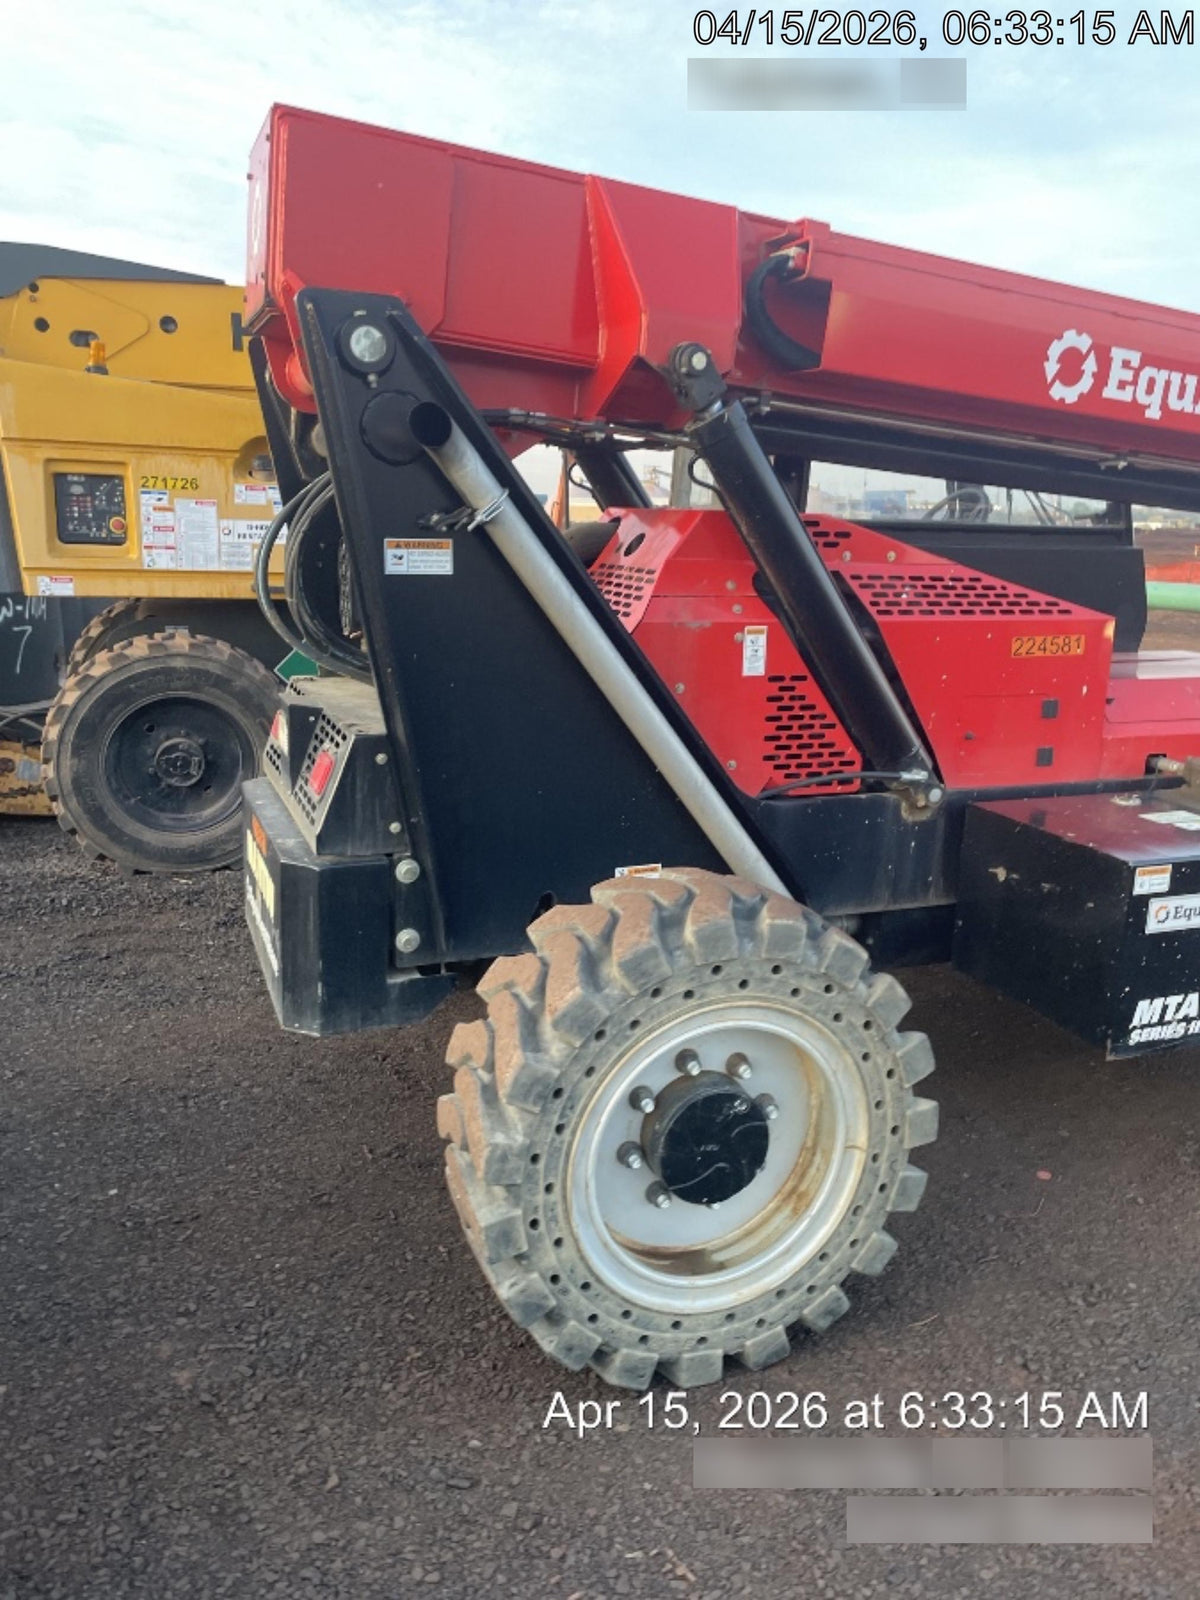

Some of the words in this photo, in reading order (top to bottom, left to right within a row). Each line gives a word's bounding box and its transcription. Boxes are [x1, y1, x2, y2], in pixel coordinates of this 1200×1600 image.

[1102, 346, 1200, 420] Equ
[140, 475, 199, 490] 271726
[12, 625, 32, 674] 7
[1013, 635, 1082, 656] 224581
[1128, 992, 1199, 1029] MTA
[1128, 1021, 1187, 1046] SERIES
